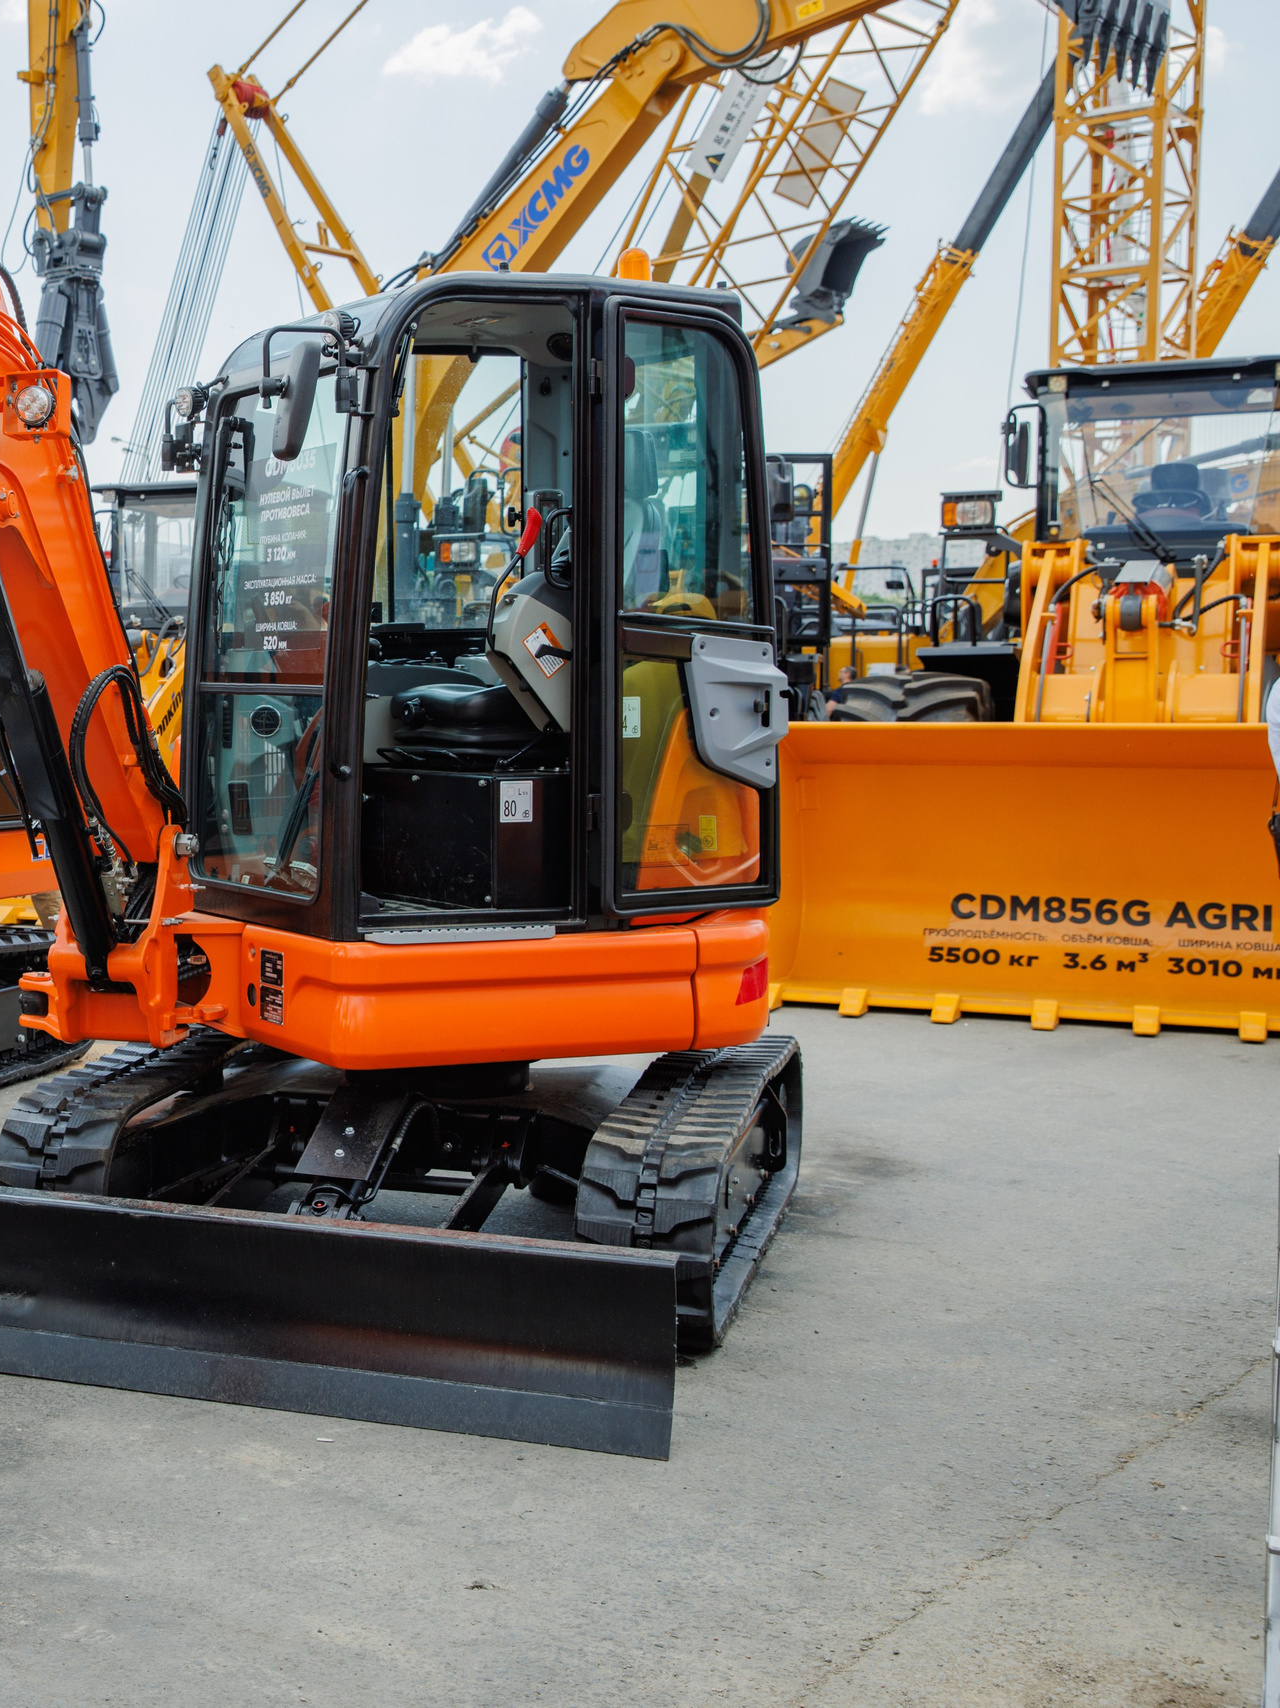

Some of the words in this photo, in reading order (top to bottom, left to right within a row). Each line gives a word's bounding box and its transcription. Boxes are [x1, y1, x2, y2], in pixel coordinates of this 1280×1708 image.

[250, 157, 271, 199] XCMG
[508, 144, 590, 250] XCMG
[260, 487, 290, 505] НУЛЕВОЙ
[291, 484, 315, 499] ВЫЛЕТ
[261, 503, 310, 522] ПРОТИВОВЕСА
[266, 548, 272, 562] 3
[273, 546, 287, 561] 120
[244, 575, 296, 590] ЭКСПЛУАТАЦИОННАЯ
[296, 574, 317, 585] МАССА:
[264, 592, 269, 606] 3
[270, 591, 285, 606] 850
[255, 622, 276, 632] ШИРИНА
[277, 621, 297, 631] КОВША:
[263, 636, 278, 650] 520
[503, 800, 517, 817] 80
[950, 893, 1151, 927] CDM856G
[1165, 901, 1273, 932] AGRI
[923, 928, 1048, 942] ГРУЗОПОДЪЁМНОСТЬ:
[1061, 933, 1102, 944] ОБЪЁМ
[1106, 936, 1153, 946] КОВША:
[1178, 938, 1232, 949] ШИРИНА
[928, 946, 1000, 965] 5500
[1009, 955, 1039, 967] кг
[1063, 952, 1107, 971] 3.6
[1167, 957, 1242, 978] 3010
[1253, 967, 1280, 979] м
